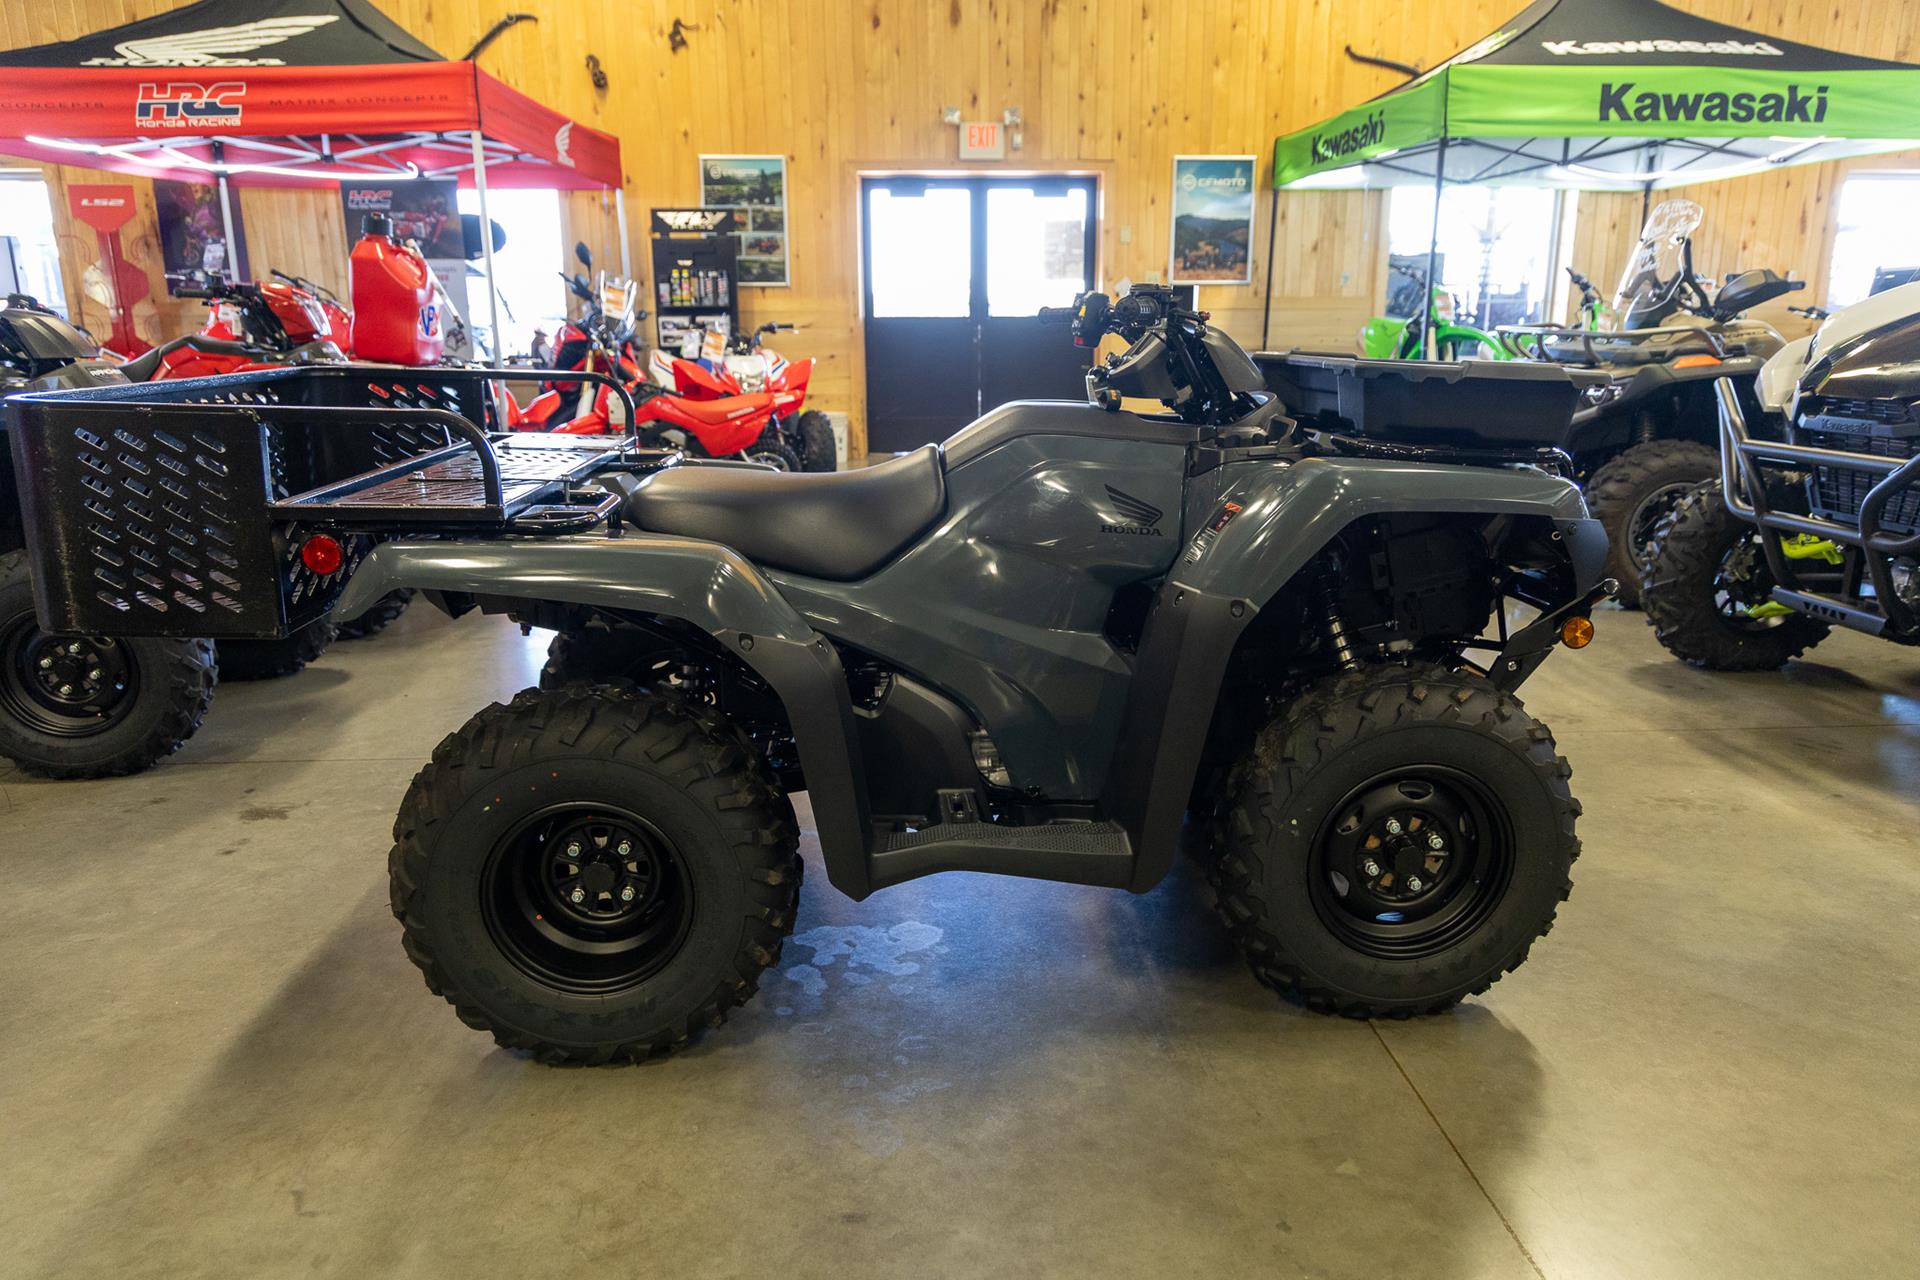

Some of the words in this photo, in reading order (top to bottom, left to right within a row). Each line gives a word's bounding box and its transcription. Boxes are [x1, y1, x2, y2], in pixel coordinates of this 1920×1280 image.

[1541, 40, 1785, 55] Kawasaki
[136, 82, 247, 118] HRC
[1599, 83, 1829, 122] Kawasaki
[136, 118, 185, 128] Honda
[188, 117, 241, 127] RACING
[968, 124, 996, 149] EXIT
[1311, 110, 1385, 166] Kawasaki
[420, 305, 436, 336] VP
[1821, 417, 1873, 434] Kawasaki
[1100, 524, 1164, 537] HONDA
